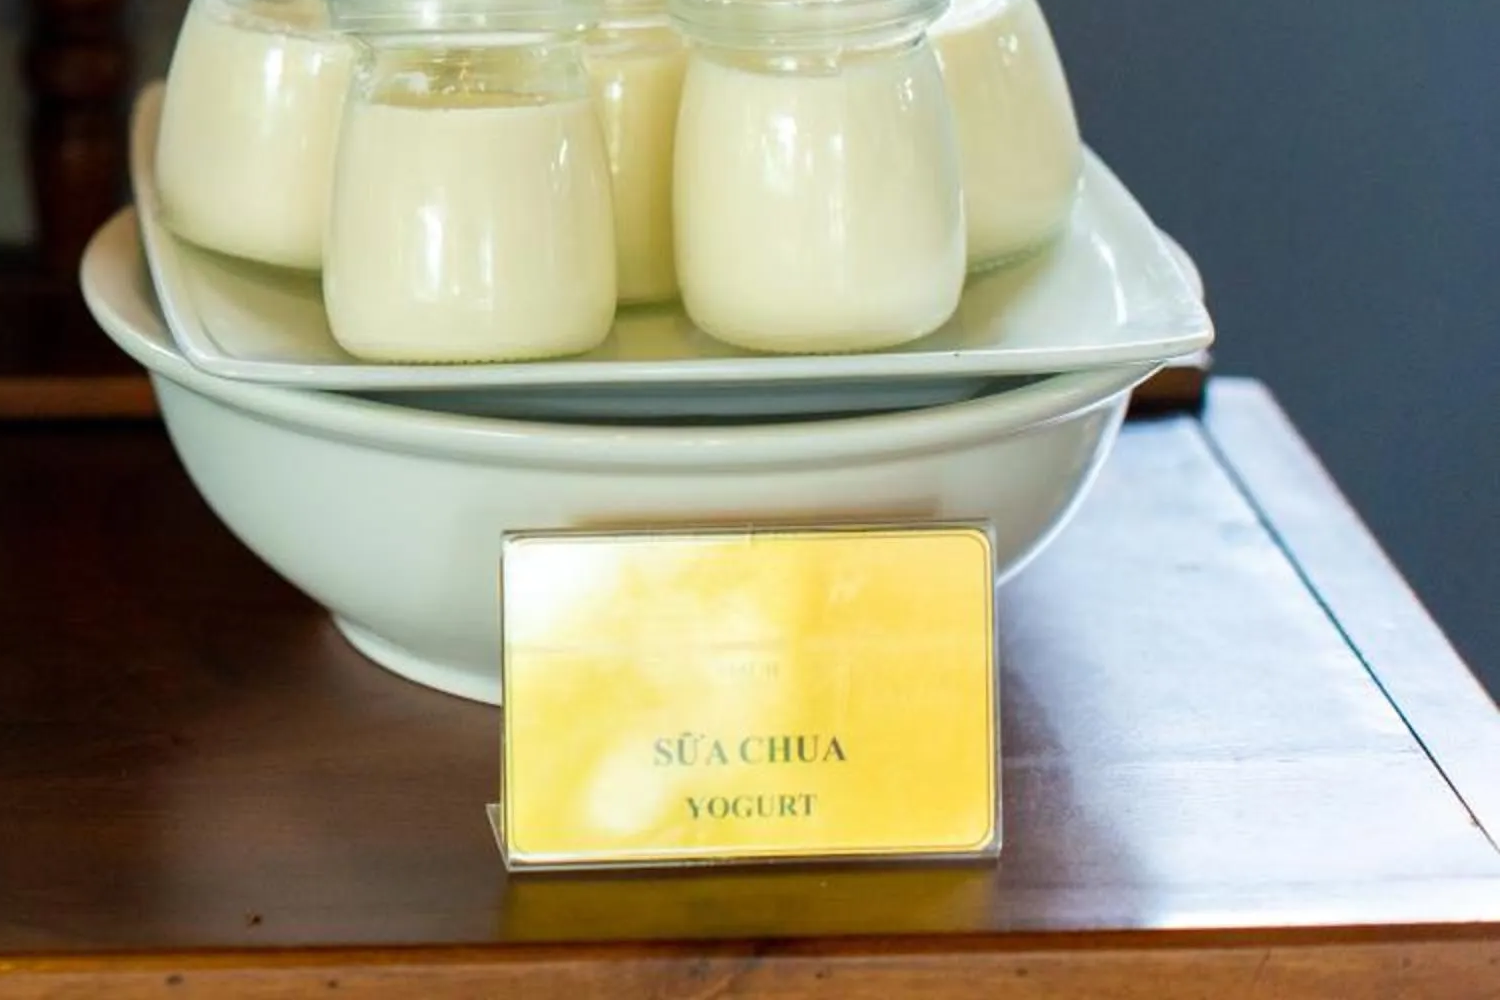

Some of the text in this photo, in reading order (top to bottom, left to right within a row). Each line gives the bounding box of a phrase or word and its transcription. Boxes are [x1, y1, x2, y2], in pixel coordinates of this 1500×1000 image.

[653, 731, 848, 766] SỮA CHUA
[685, 793, 819, 820] YOGURT
